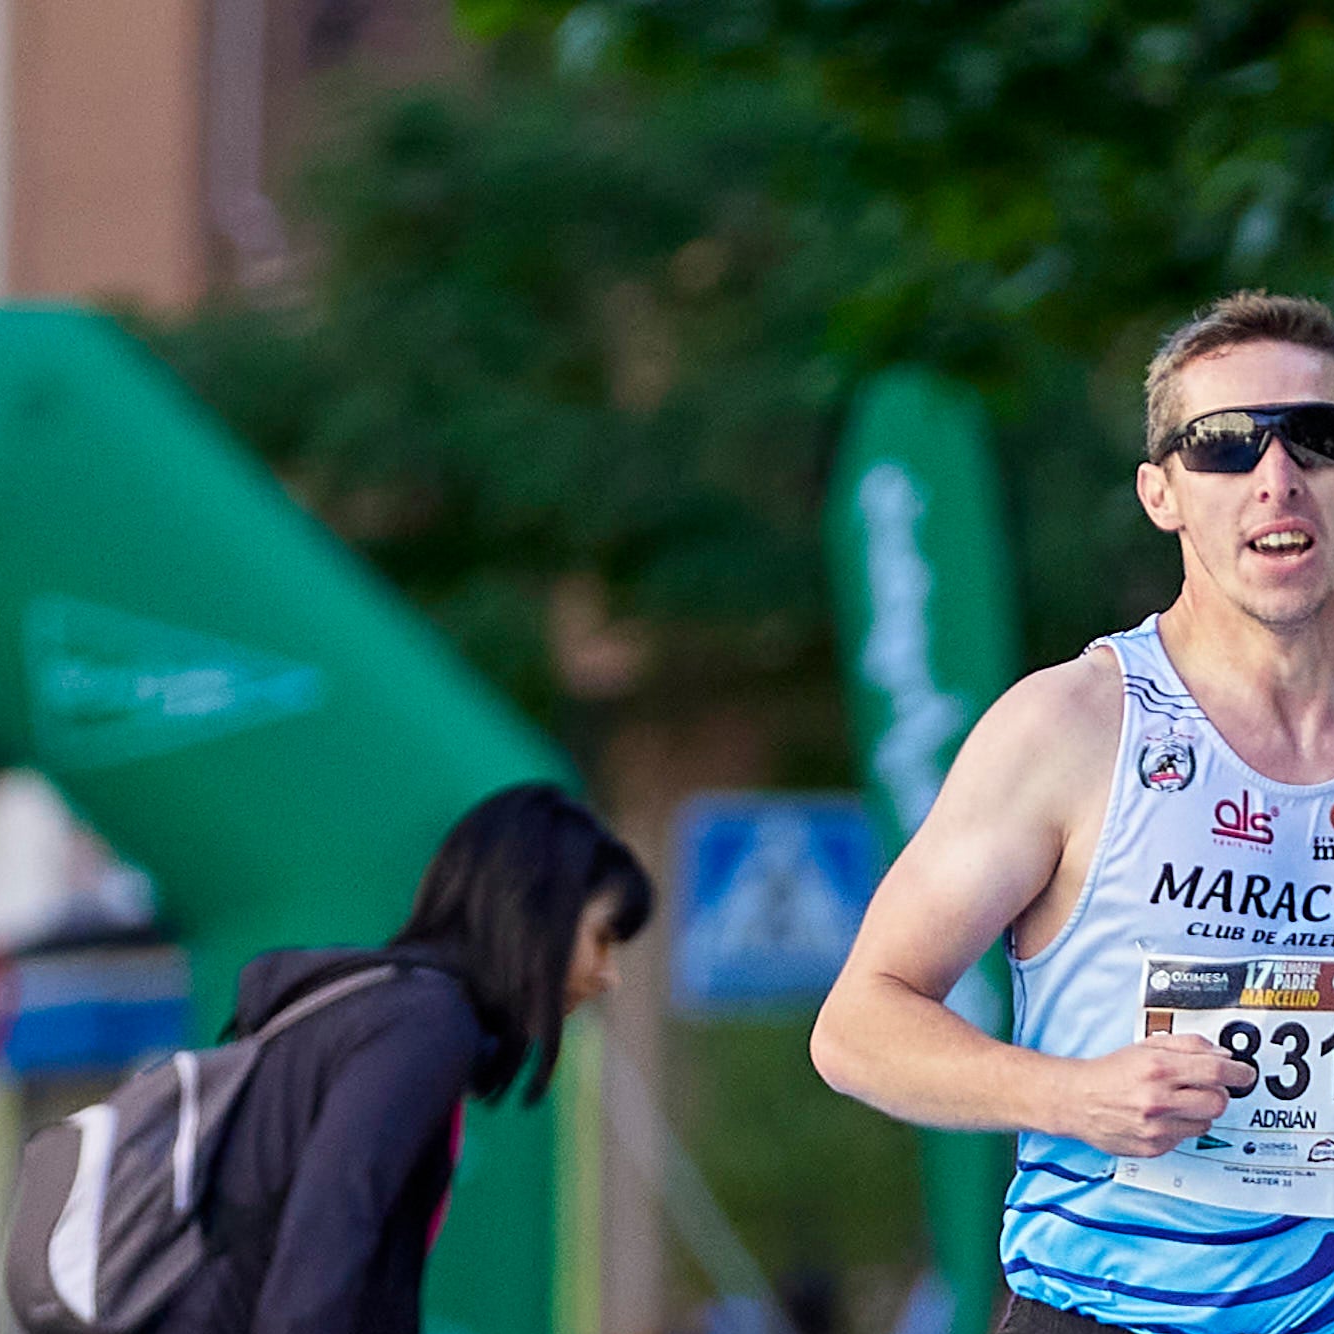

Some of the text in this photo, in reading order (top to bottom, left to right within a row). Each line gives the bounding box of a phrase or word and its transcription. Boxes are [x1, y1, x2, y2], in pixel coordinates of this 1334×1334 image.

[1186, 921, 1245, 941] CLUB
[1251, 929, 1278, 945] DE
[1171, 970, 1229, 984] OXIMESA
[1244, 961, 1274, 990] 17
[1272, 972, 1318, 990] PADRE
[1239, 987, 1320, 1008] MARCELINO
[1249, 1106, 1317, 1129] ADRIÁN
[1242, 1176, 1280, 1186] MASTER
